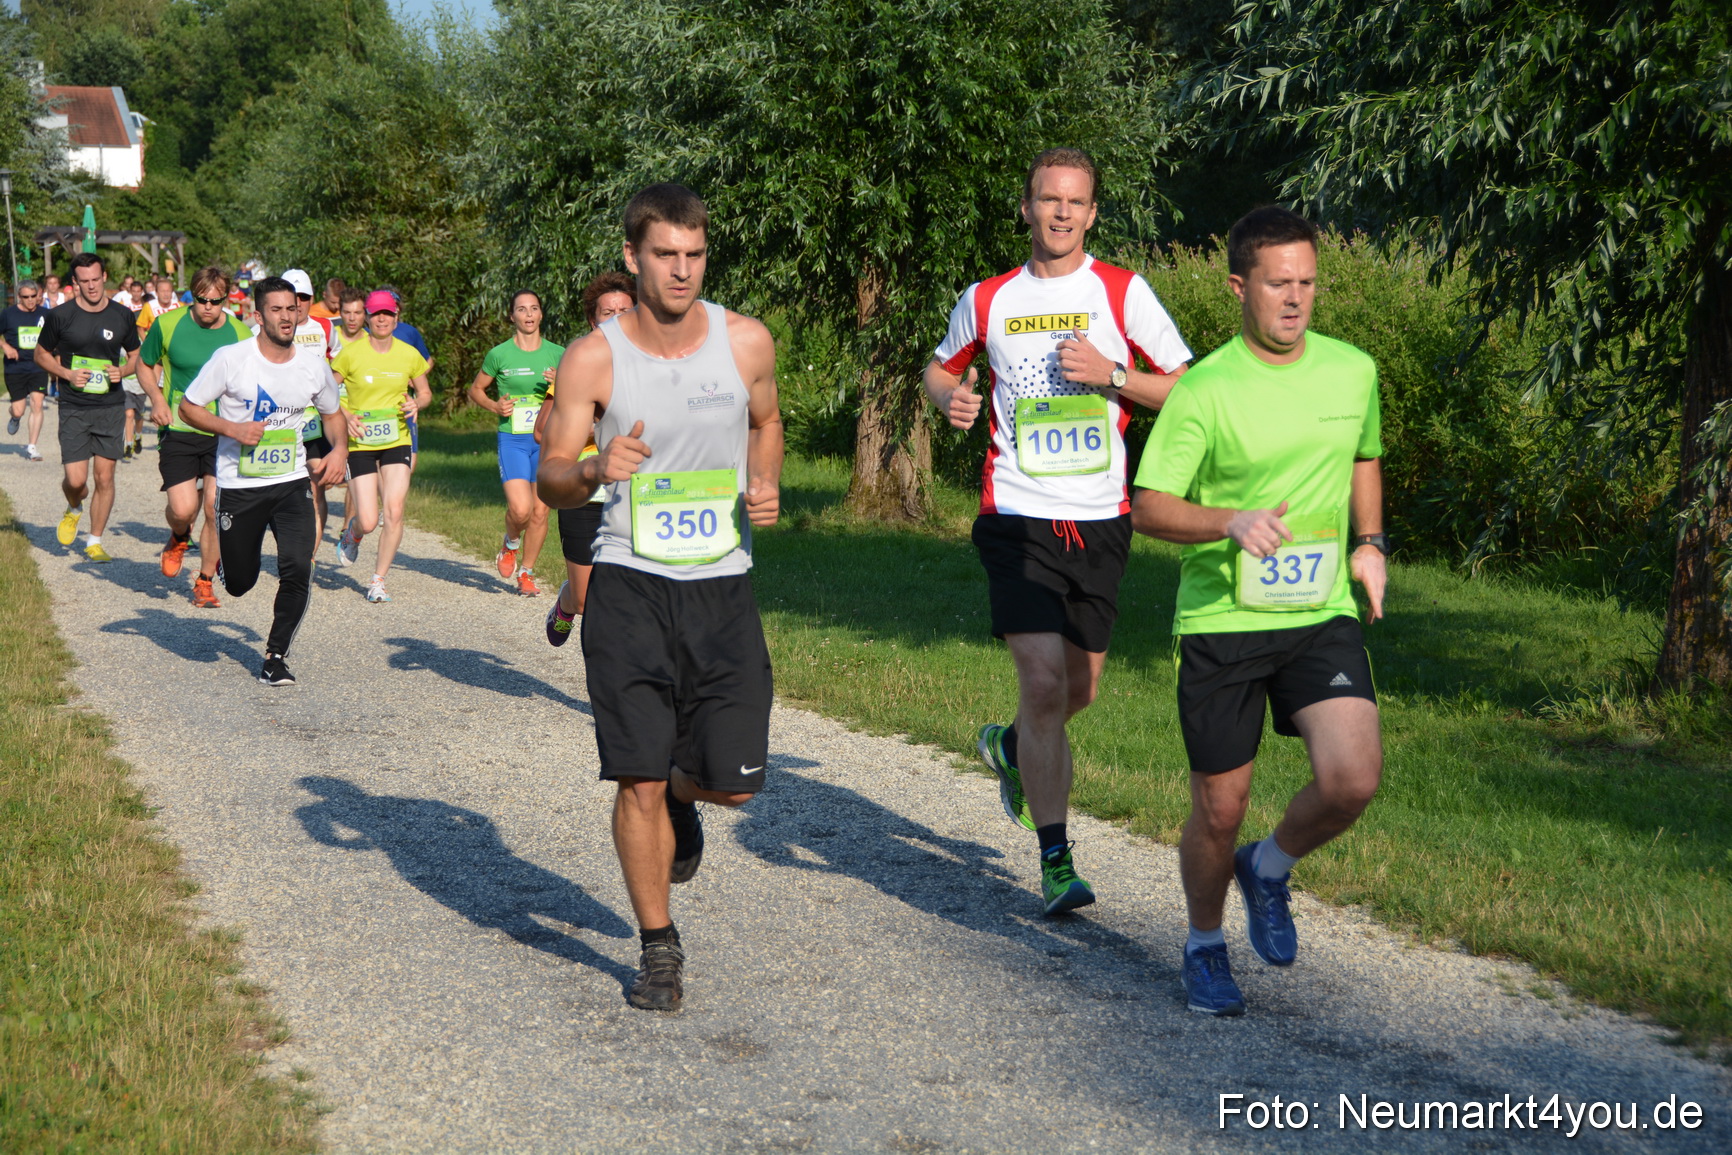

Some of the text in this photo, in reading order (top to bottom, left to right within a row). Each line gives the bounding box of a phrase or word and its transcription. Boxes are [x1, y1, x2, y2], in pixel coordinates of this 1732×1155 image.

[1009, 315, 1081, 332] ONLINE
[687, 395, 734, 405] PLATZHIRSCH
[1028, 426, 1102, 455] 1016
[247, 448, 290, 464] 1463
[655, 508, 718, 540] 350
[1259, 552, 1323, 585] 337
